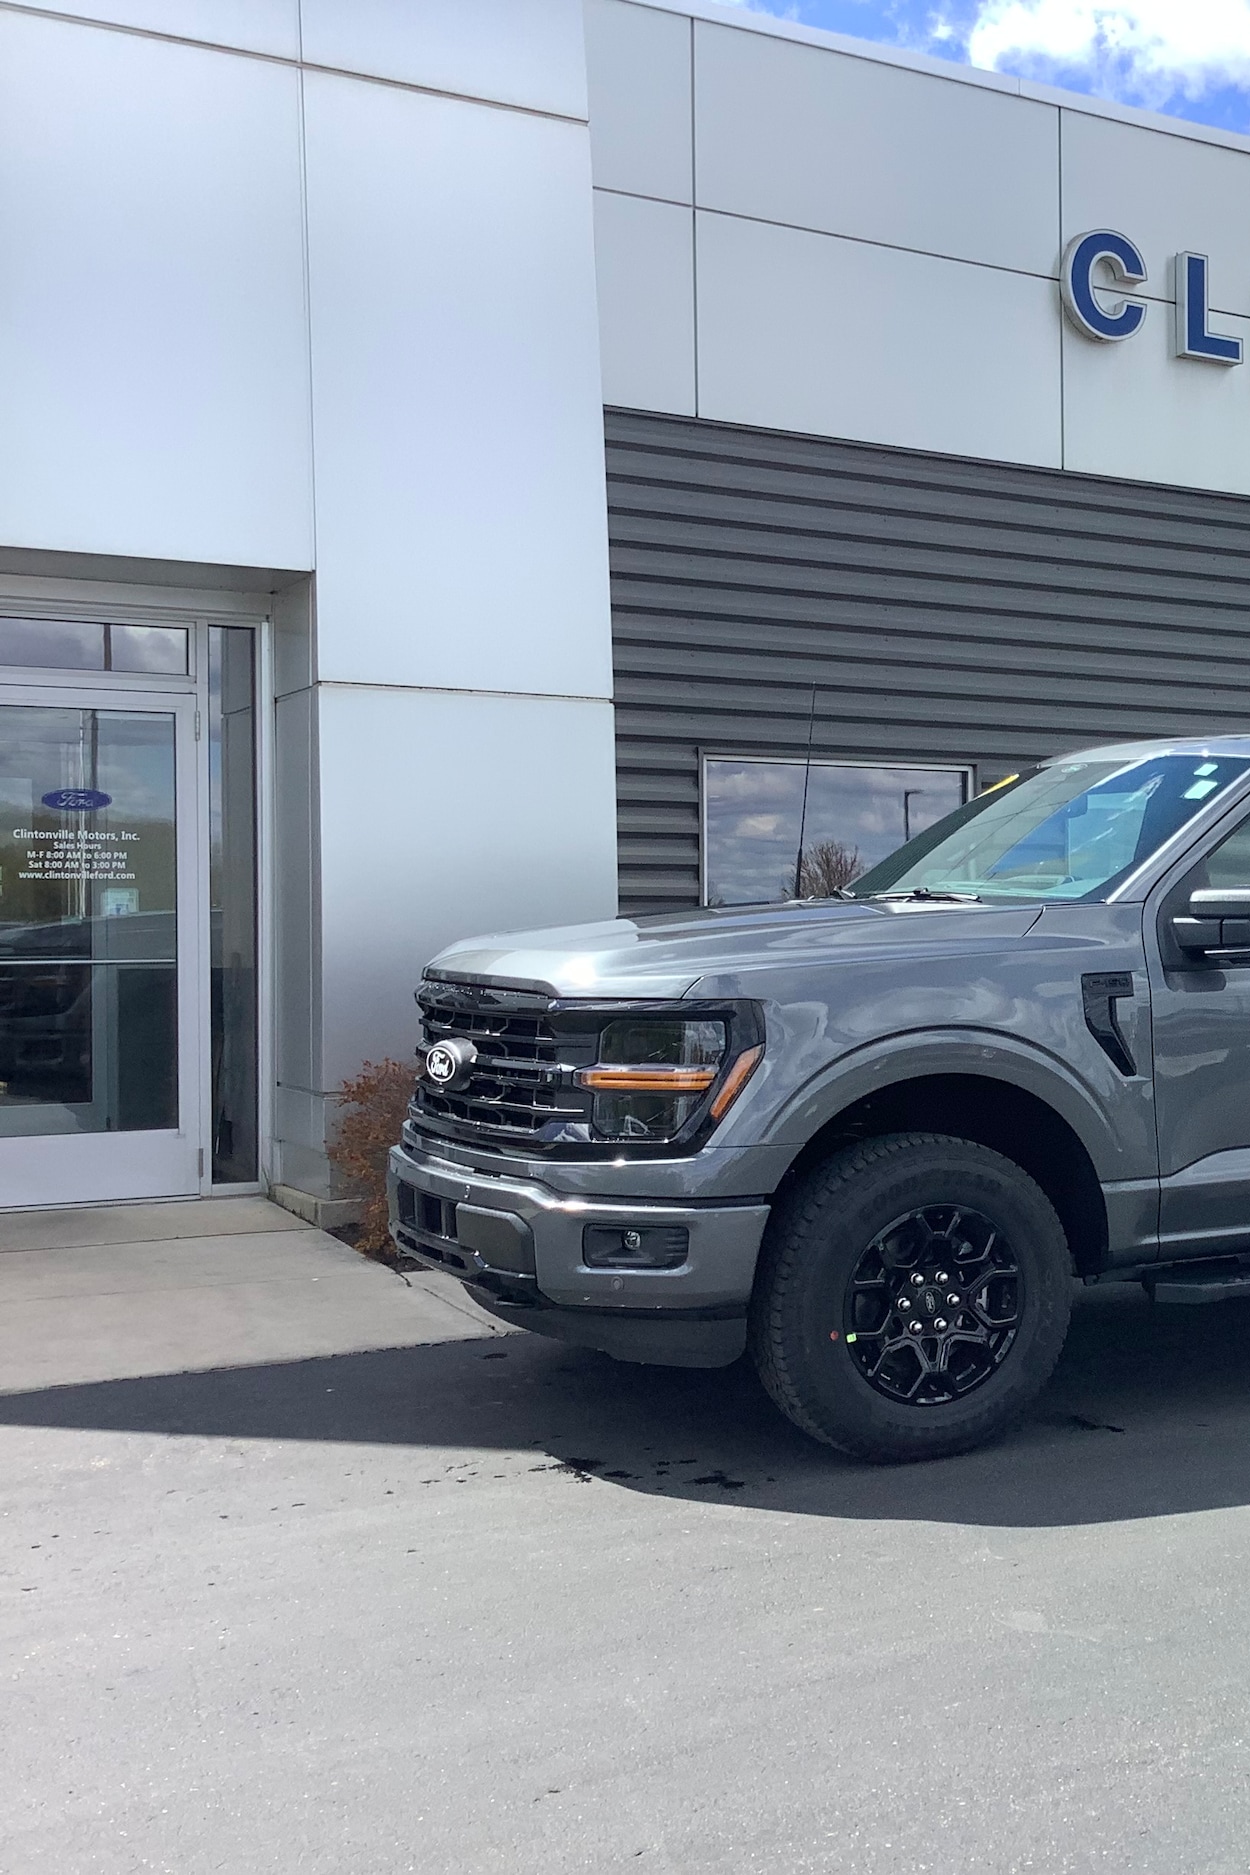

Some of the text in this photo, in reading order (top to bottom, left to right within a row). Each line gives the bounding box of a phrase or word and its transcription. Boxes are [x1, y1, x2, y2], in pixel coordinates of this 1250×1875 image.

[13, 829, 140, 841] Clintonville Motors, Inc.
[53, 842, 102, 850] Sales Hours
[27, 851, 128, 860] M-F 8:00 AM to 6:00 PM
[28, 861, 43, 869] Sat
[44, 861, 62, 869] 8:00
[64, 861, 79, 869] AM
[19, 871, 136, 880] www.clintonvilleford.com
[430, 1050, 450, 1077] Ford
